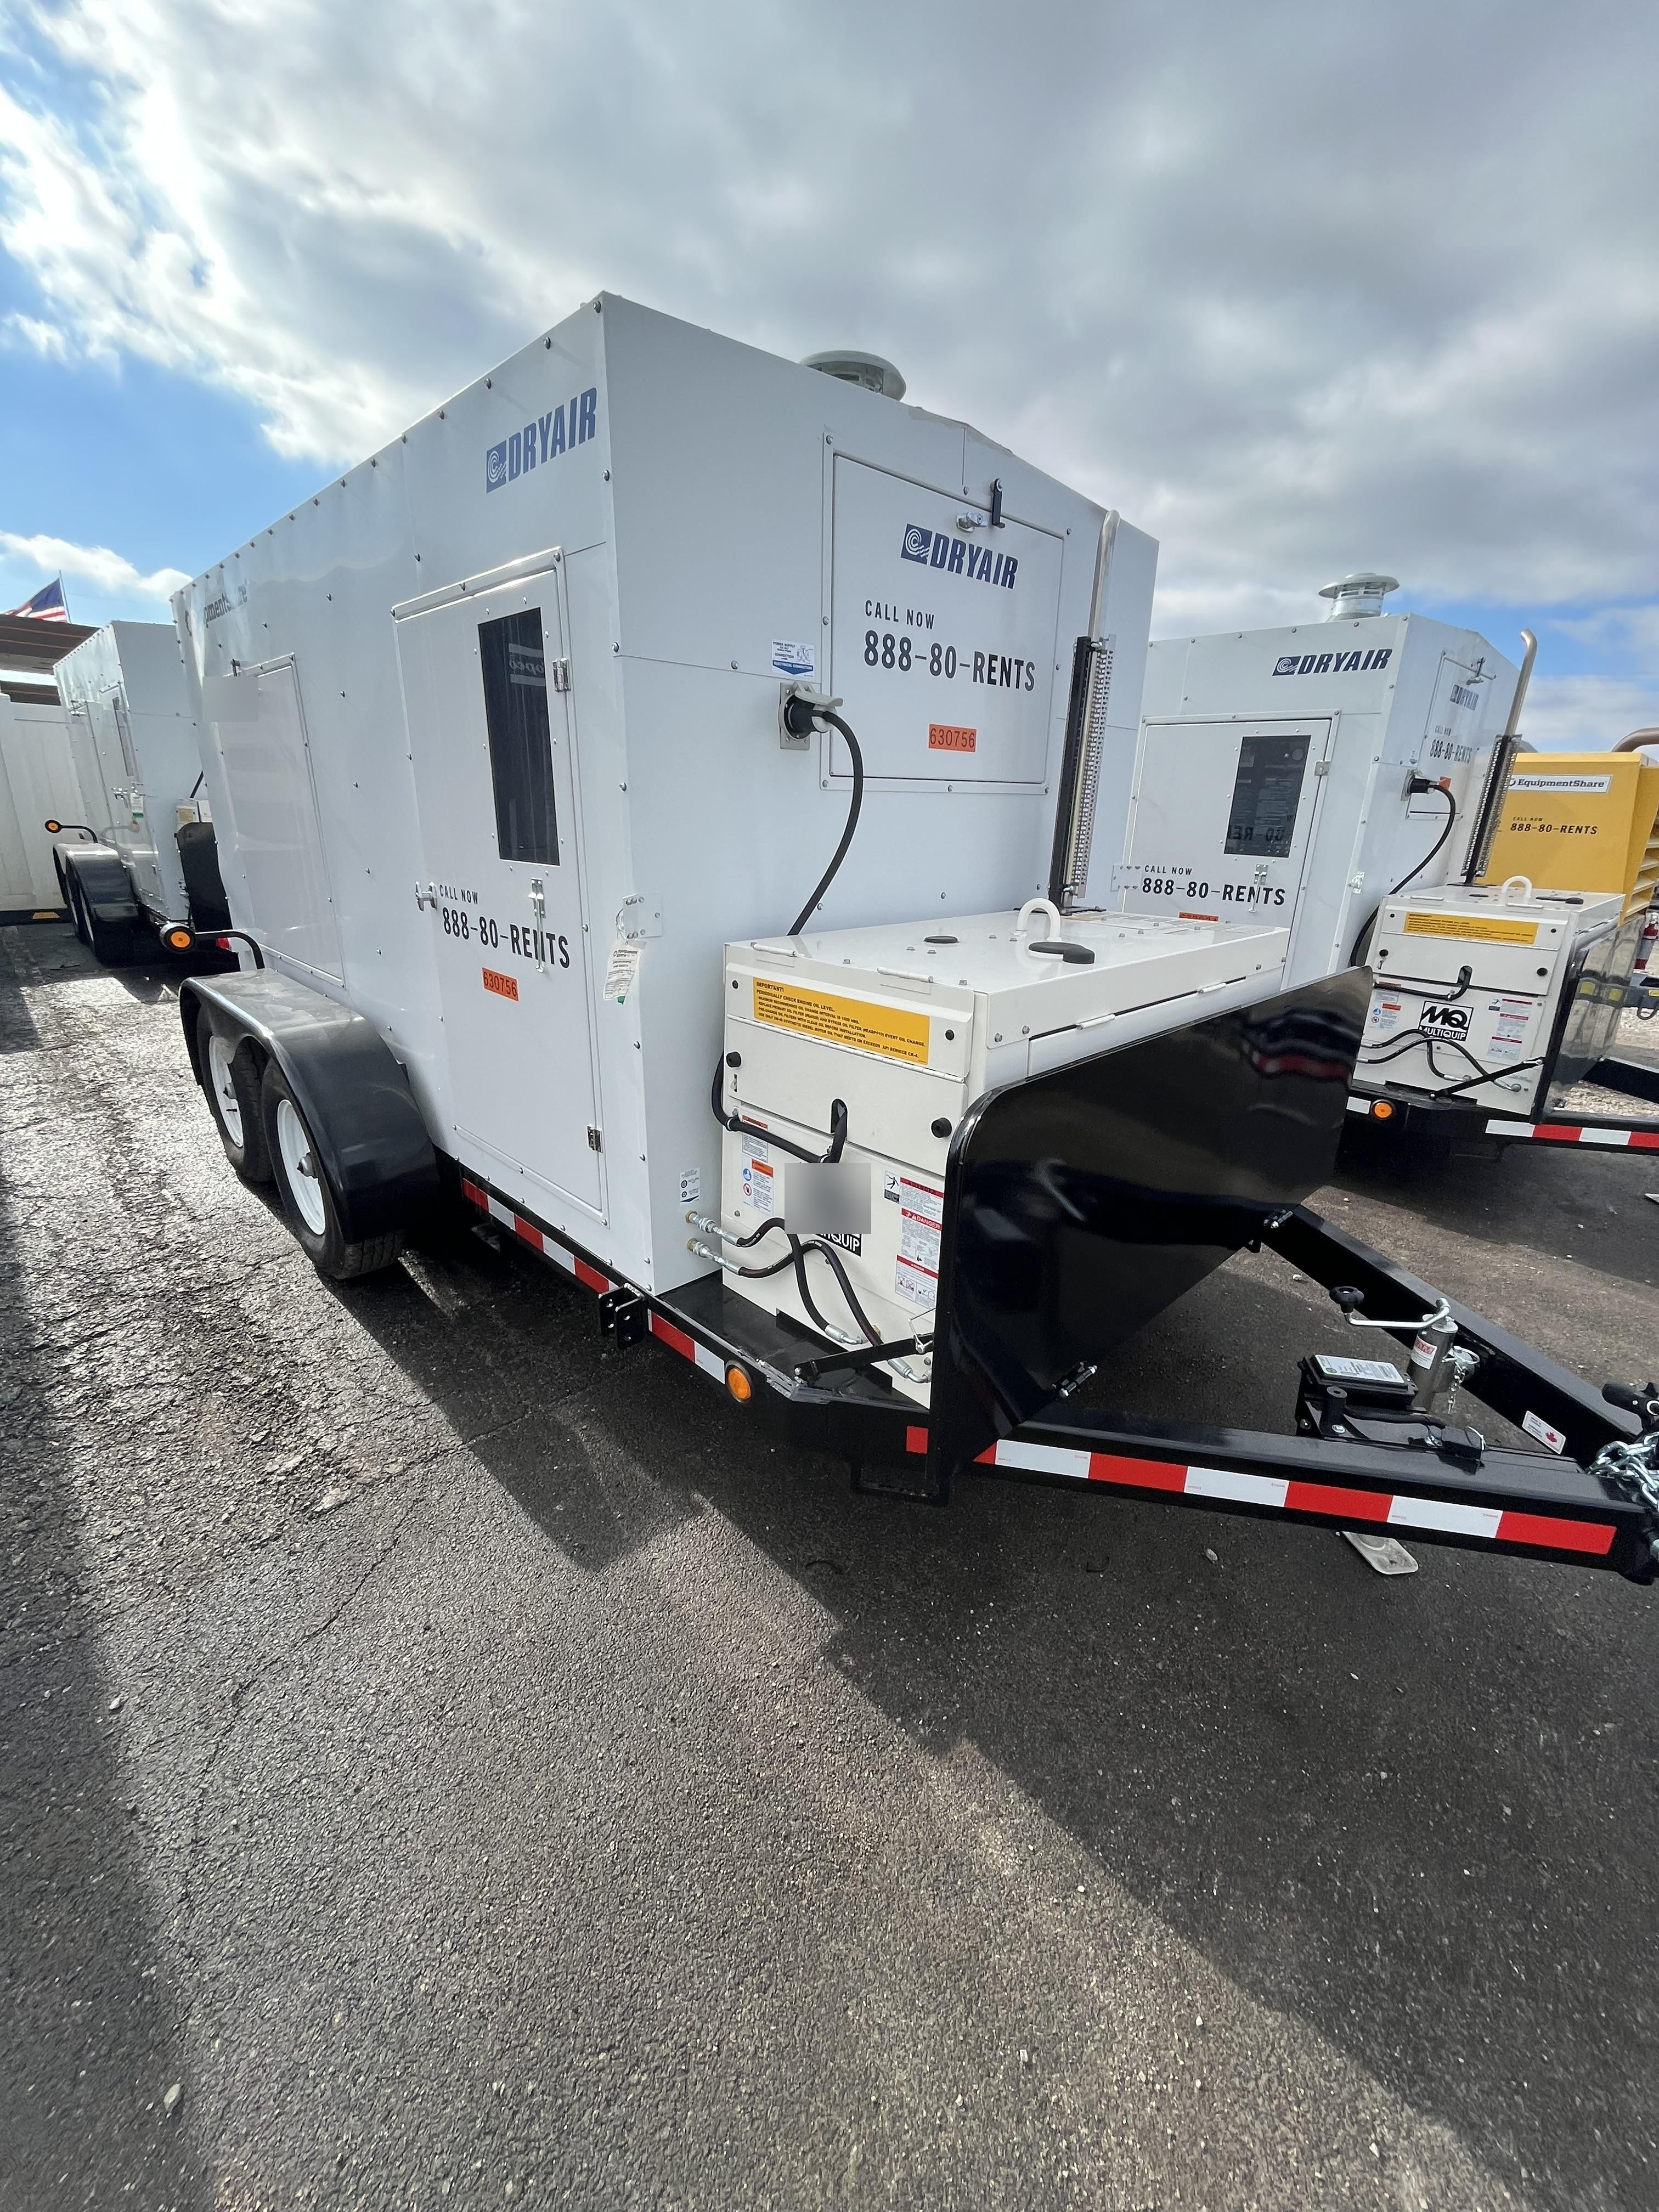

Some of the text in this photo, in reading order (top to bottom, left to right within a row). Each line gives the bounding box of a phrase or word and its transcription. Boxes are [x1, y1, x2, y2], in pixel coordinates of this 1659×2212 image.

[508, 387, 597, 482] DRYAIR
[929, 533, 1019, 589] DRYAIR
[865, 600, 935, 630] CALL NOW
[864, 630, 1035, 691] 888-80-RENTS
[1297, 648, 1392, 675] DRYAIR
[929, 727, 975, 749] 630756
[1517, 779, 1605, 788] EquipmentShare
[1510, 823, 1598, 834] 888-80-RENTS
[1145, 865, 1193, 876] CALL NOW
[439, 884, 479, 905] CALL NOW
[1142, 878, 1285, 905] 888-80-RENTS
[483, 970, 517, 997] 630756
[756, 981, 784, 992] IMPORTANT!
[756, 990, 782, 999] PERIODICALLY
[1419, 1025, 1466, 1040] MULTIQUIP
[916, 1217, 940, 1229] DANGER
